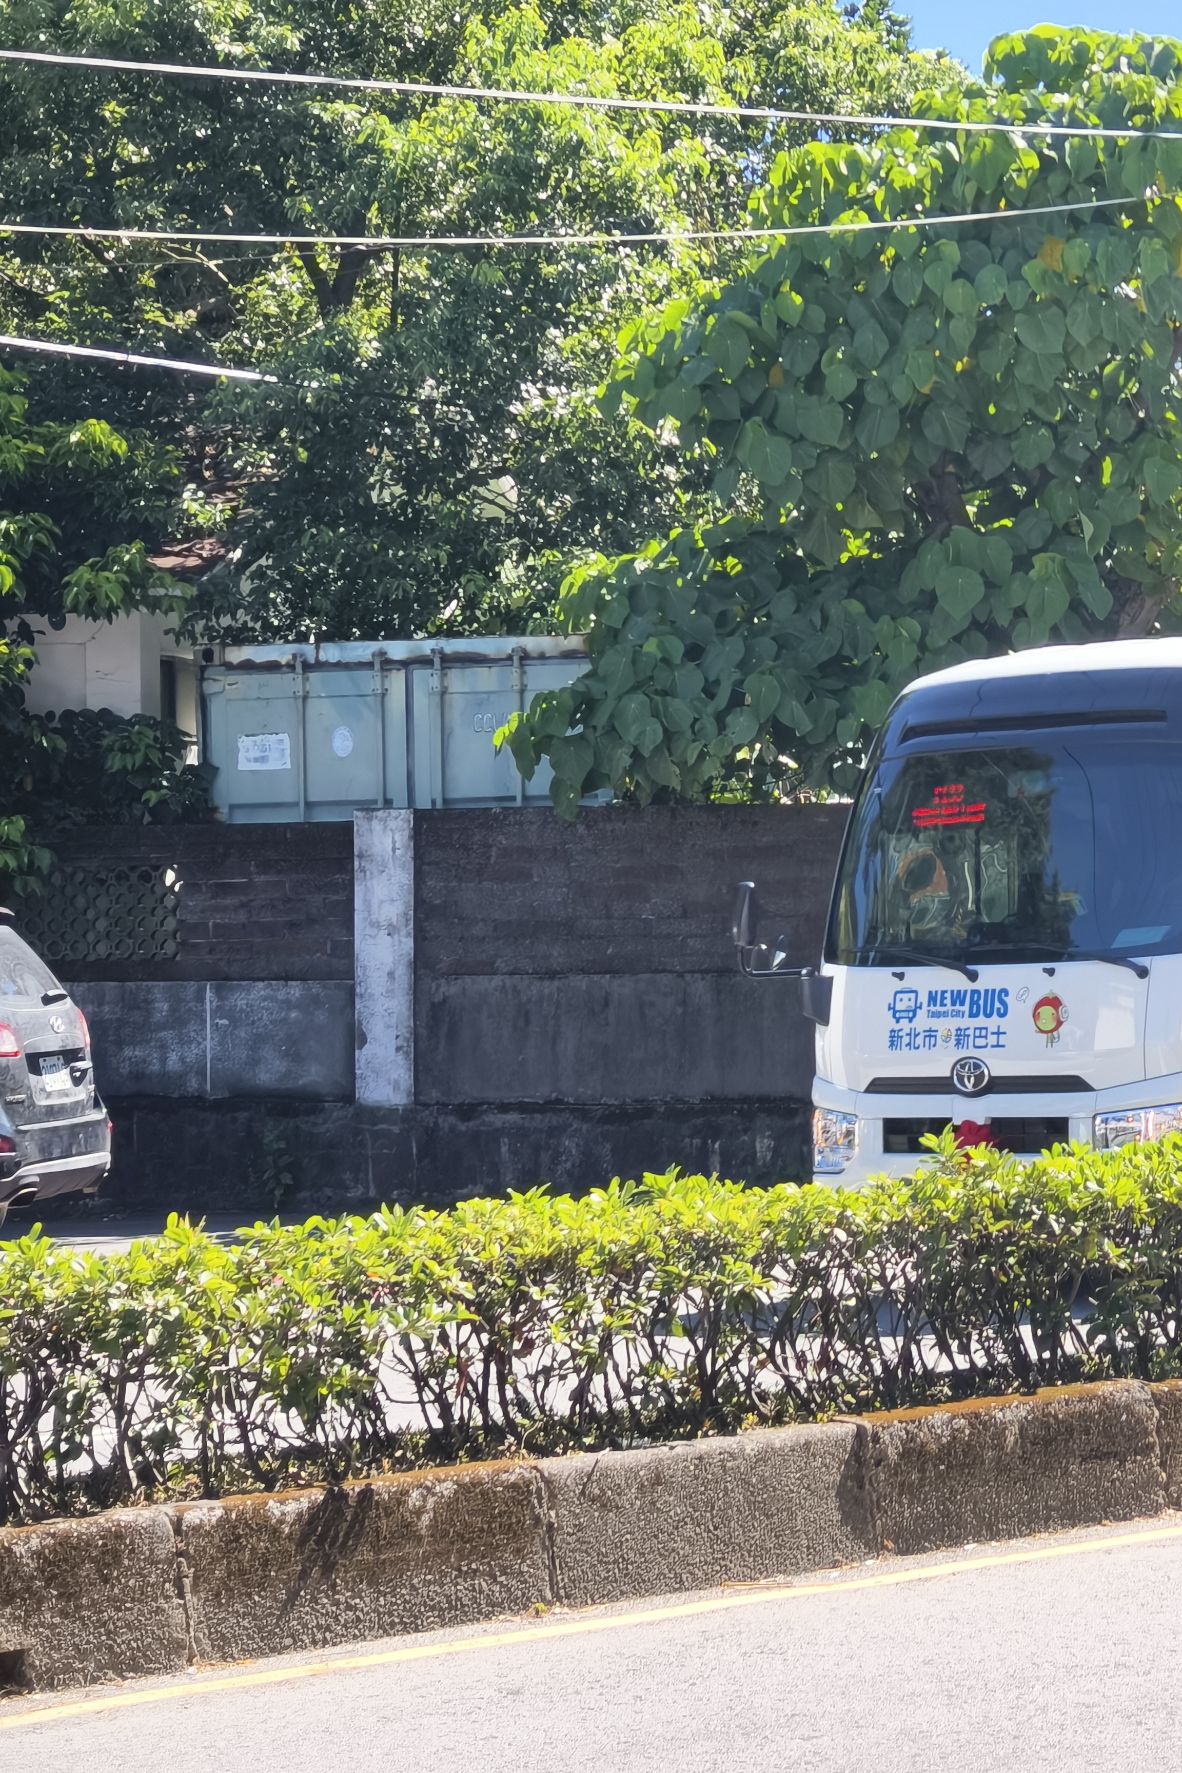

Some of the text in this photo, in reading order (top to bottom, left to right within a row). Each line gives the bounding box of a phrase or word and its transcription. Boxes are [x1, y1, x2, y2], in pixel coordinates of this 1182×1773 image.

[926, 1009, 966, 1020] Taipei City
[927, 987, 1010, 1019] NEW BUS
[888, 1025, 1007, 1051] 新北市 新巴士
